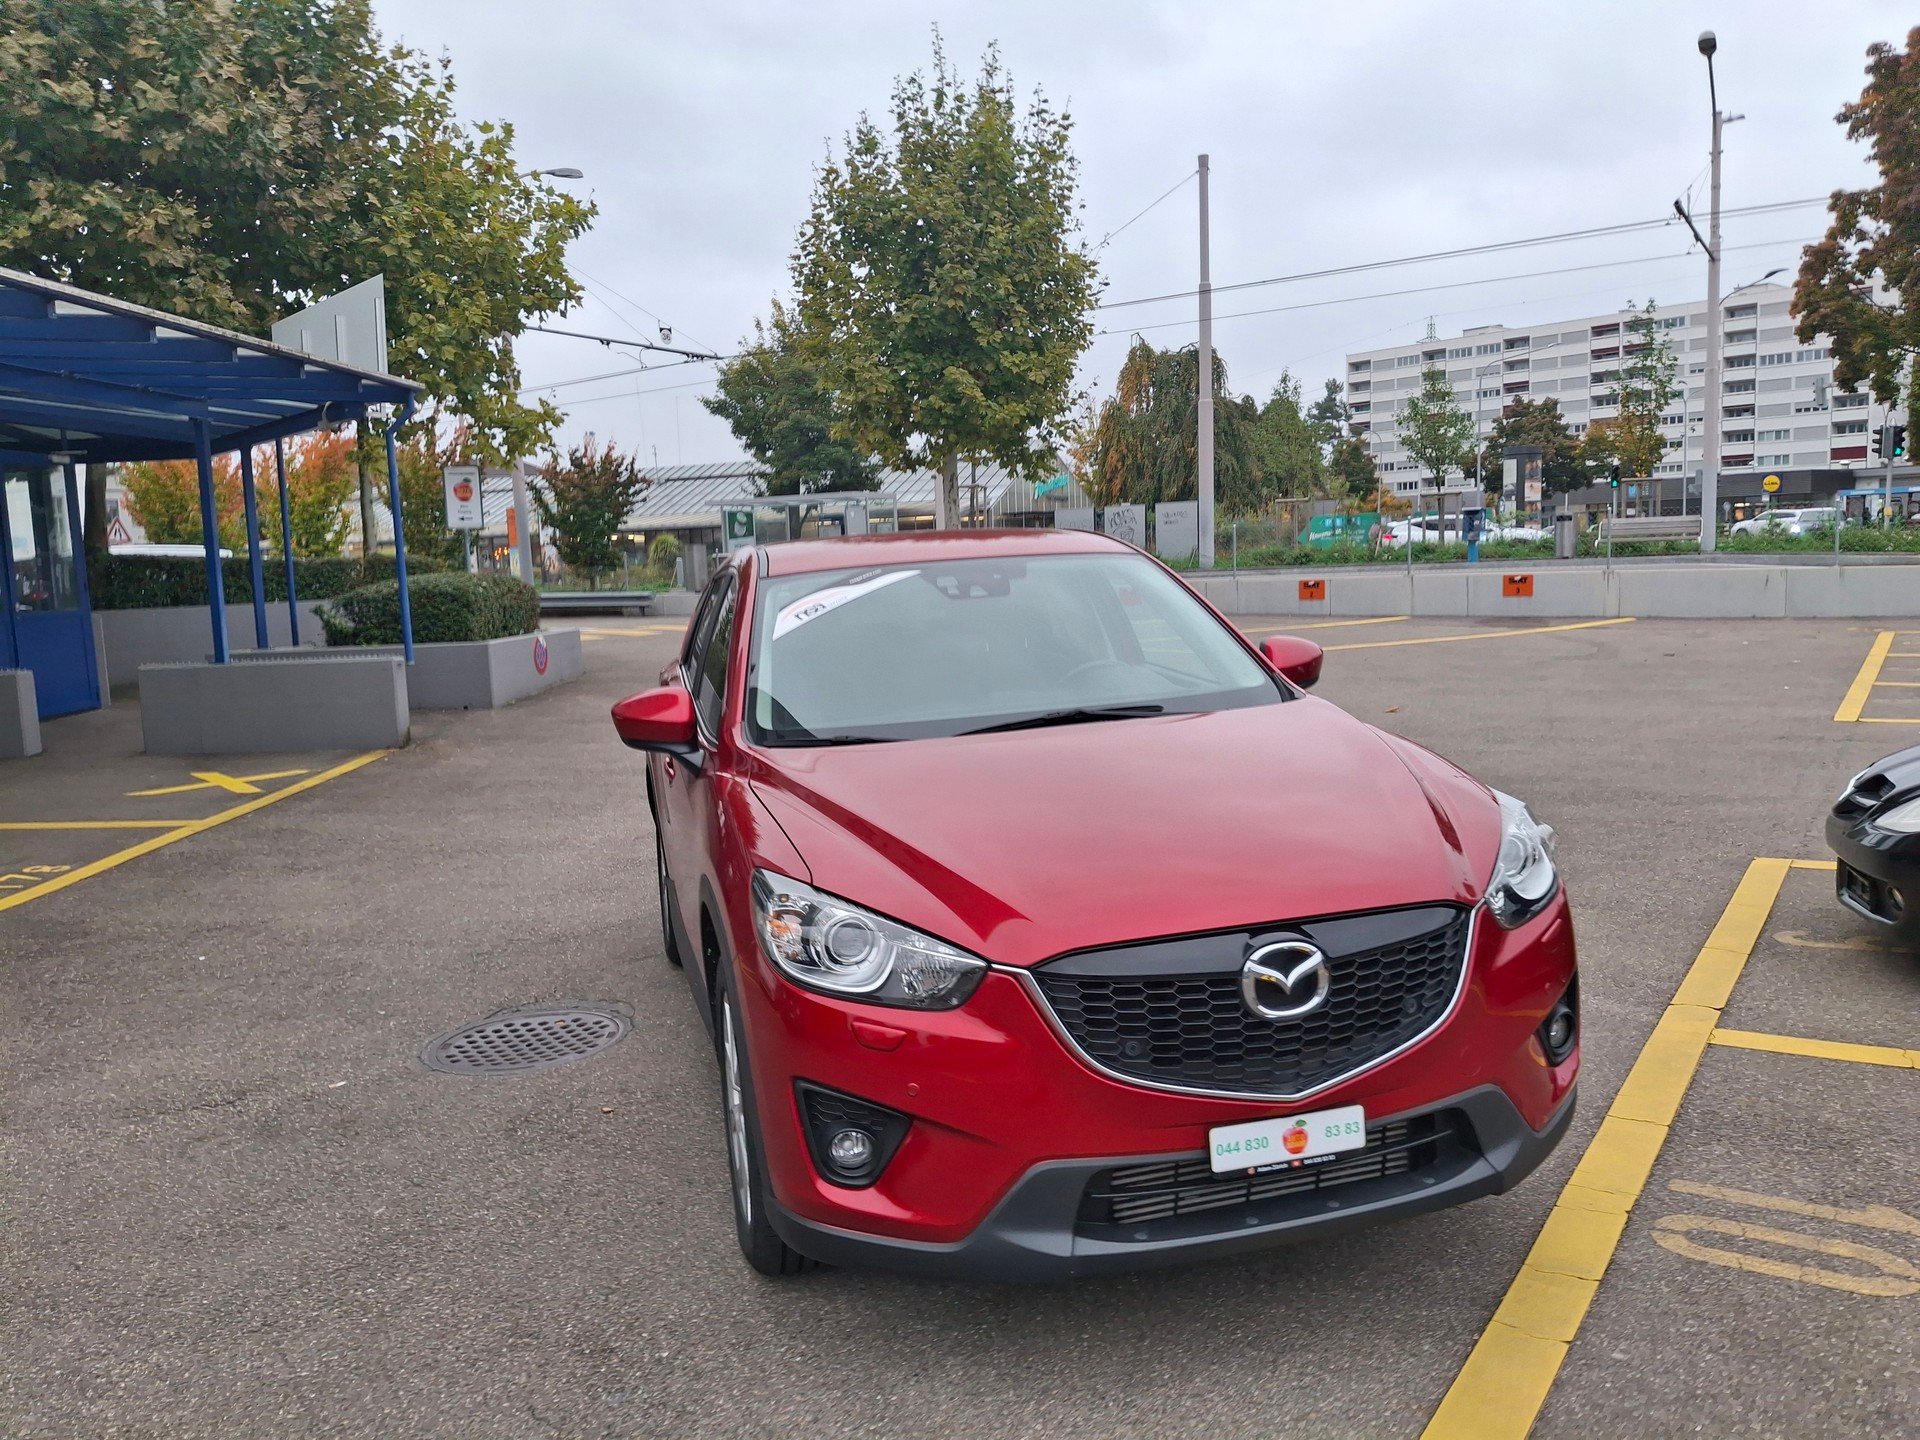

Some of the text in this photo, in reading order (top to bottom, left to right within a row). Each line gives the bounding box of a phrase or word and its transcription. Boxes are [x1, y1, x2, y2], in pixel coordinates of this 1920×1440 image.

[1216, 1141, 1240, 1156] 044
[1245, 1136, 1269, 1151] 830
[1325, 1125, 1341, 1138] 83
[1345, 1121, 1361, 1134] 83
